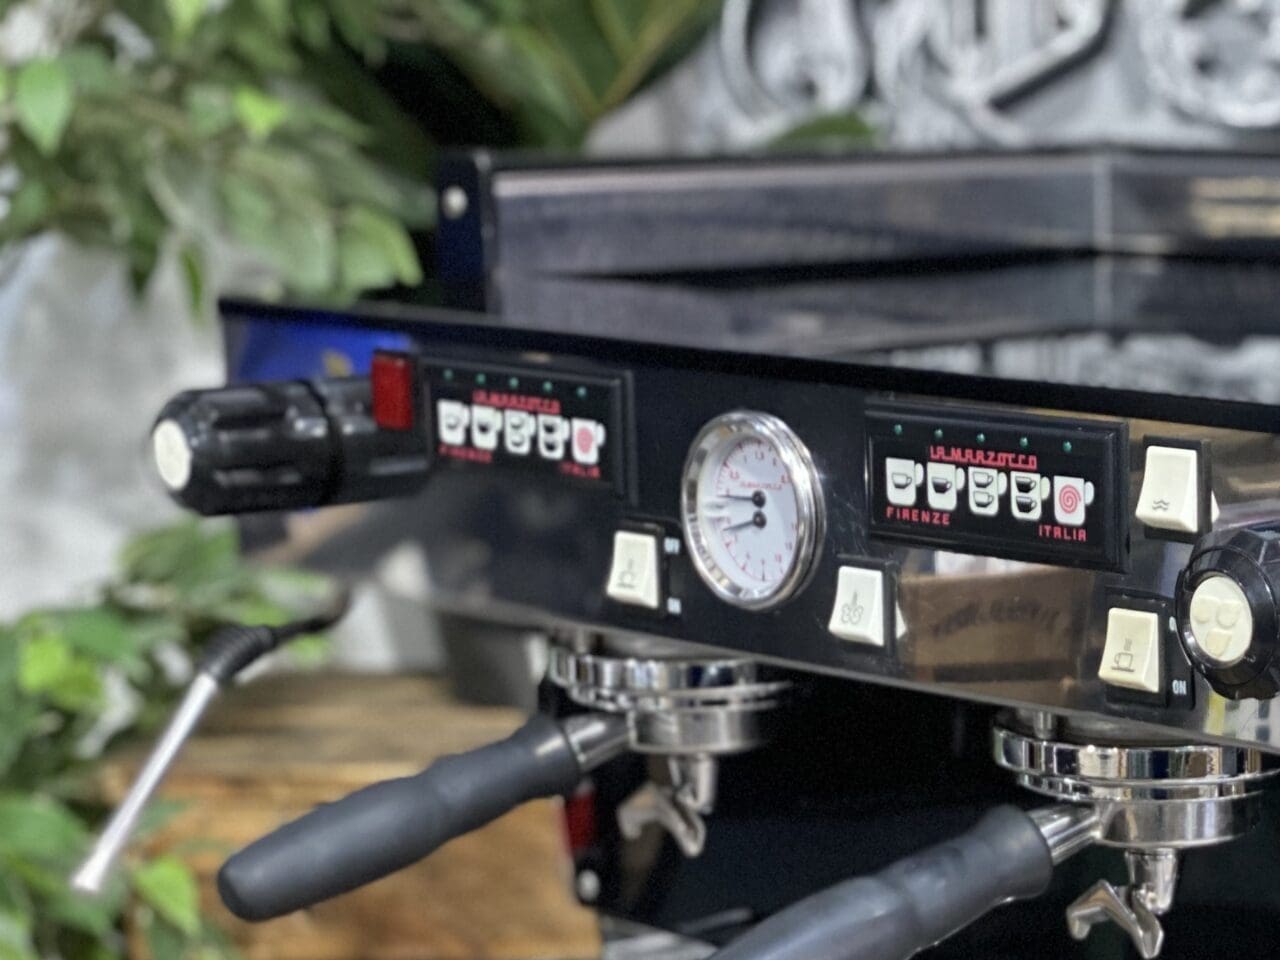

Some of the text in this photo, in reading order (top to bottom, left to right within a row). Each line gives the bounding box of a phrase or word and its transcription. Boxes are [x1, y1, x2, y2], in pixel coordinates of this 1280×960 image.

[886, 506, 951, 526] FIRENZE
[1038, 524, 1087, 542] ITALIA
[1172, 679, 1187, 696] ON
